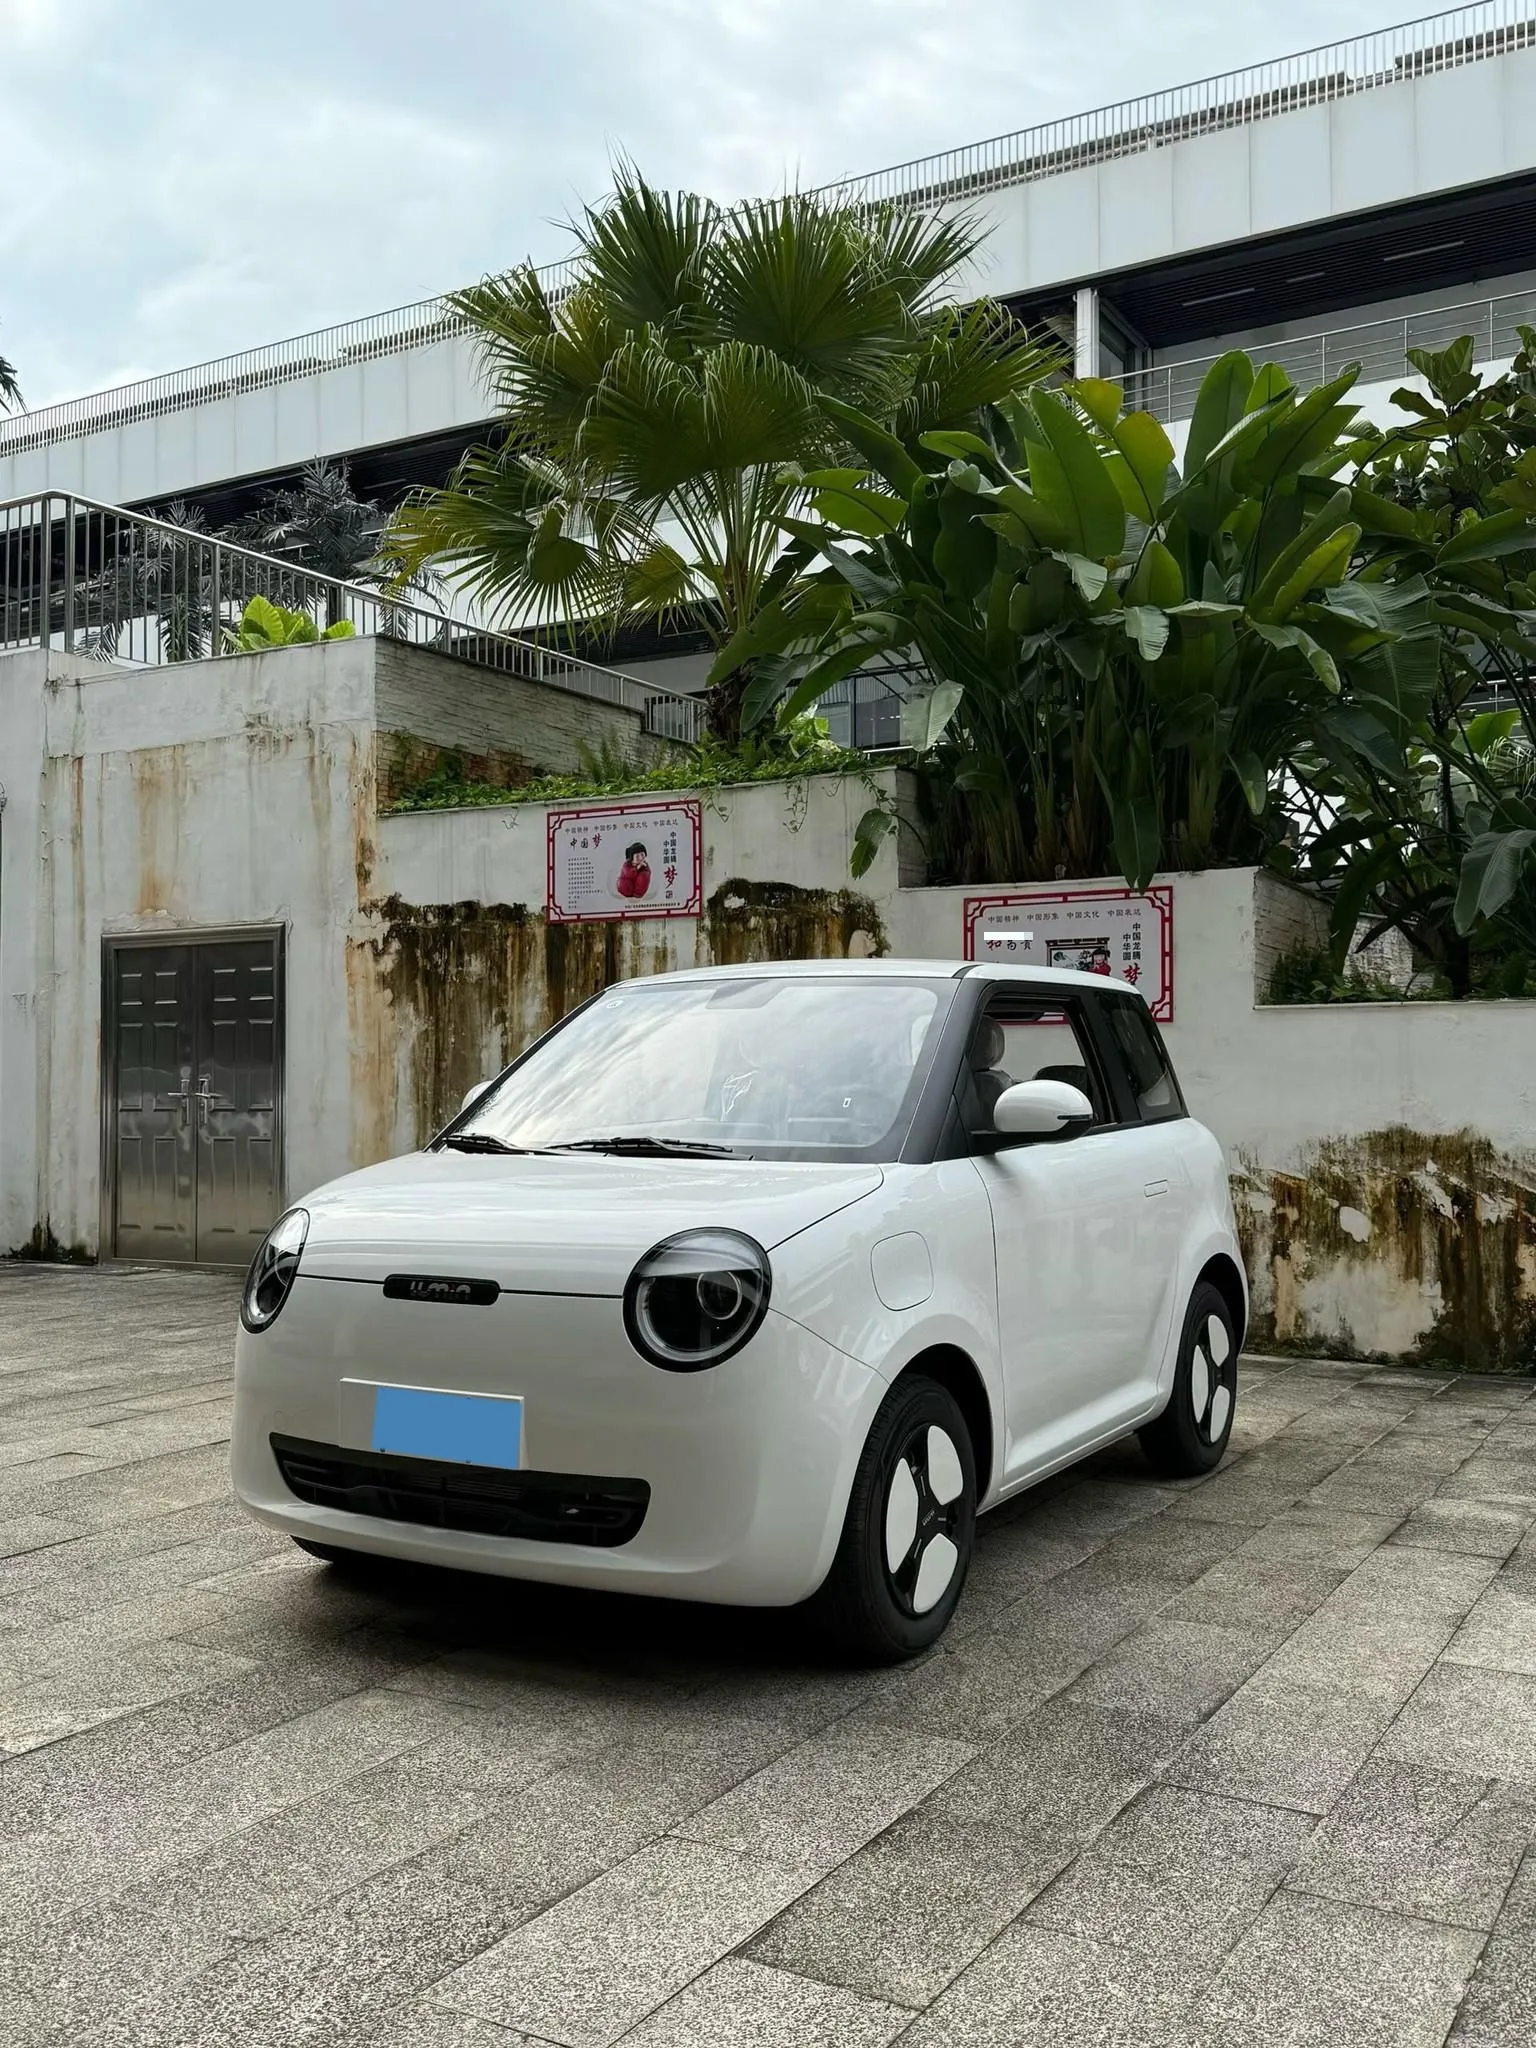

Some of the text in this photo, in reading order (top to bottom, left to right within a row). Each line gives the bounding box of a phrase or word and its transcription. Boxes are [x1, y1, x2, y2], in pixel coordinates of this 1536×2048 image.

[570, 833, 602, 850] 中国梦
[663, 865, 678, 889] 梦
[988, 908, 1141, 923] 中国精神 中国形象 中国文化 中国表达
[1122, 933, 1131, 960] 中华圆
[1132, 922, 1141, 960] 中国龙腾
[1122, 962, 1143, 985] 梦
